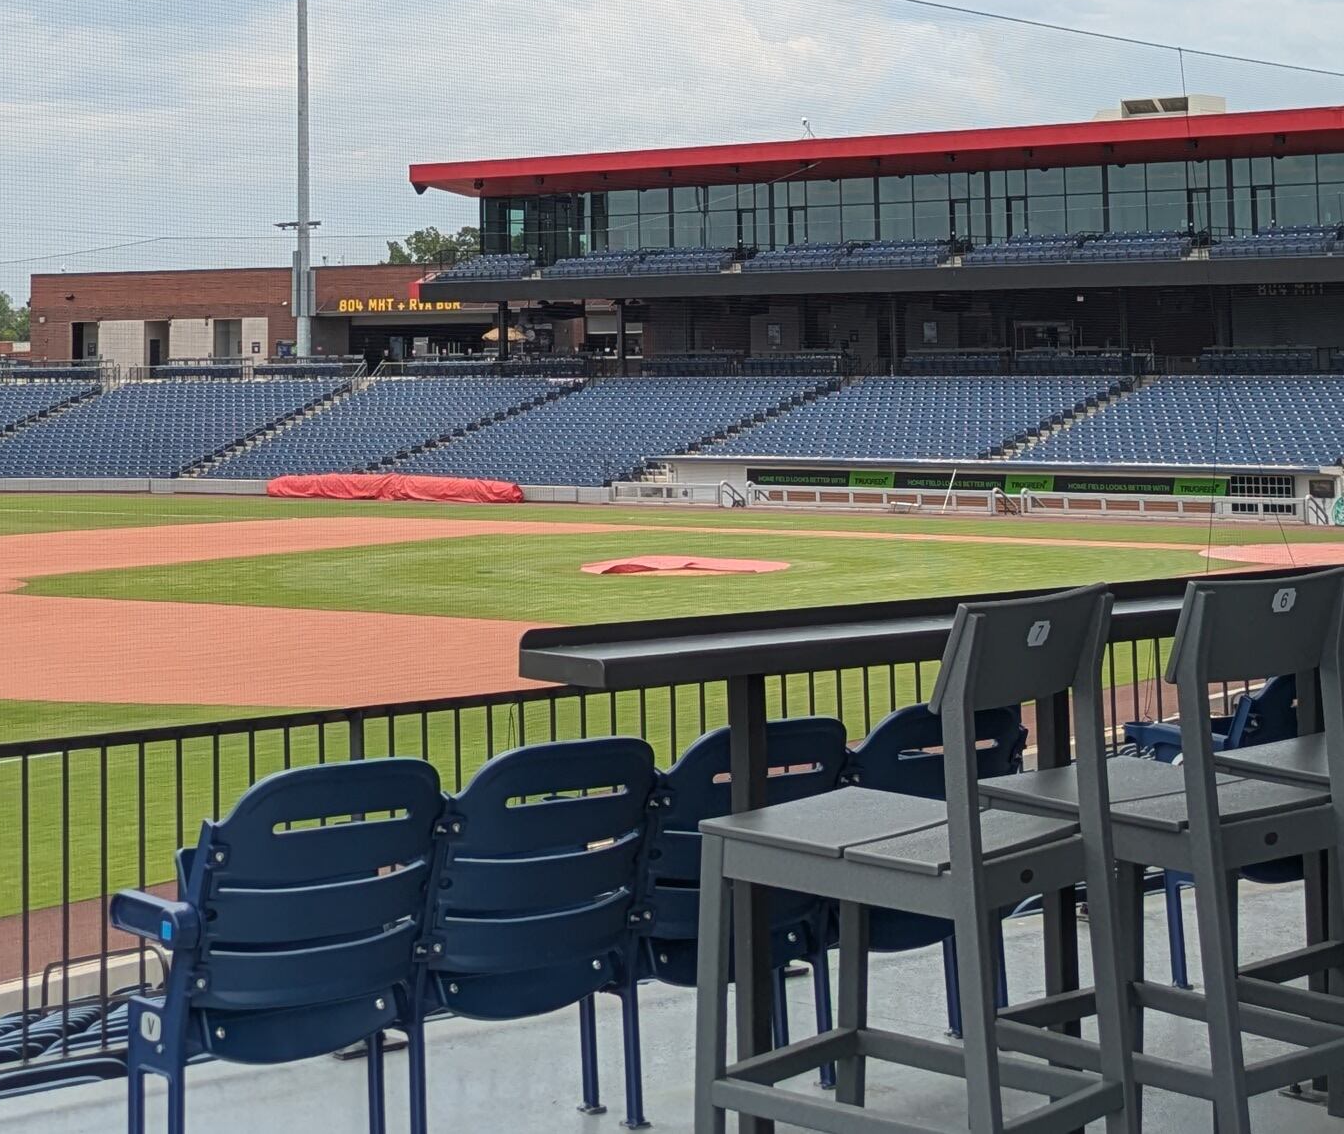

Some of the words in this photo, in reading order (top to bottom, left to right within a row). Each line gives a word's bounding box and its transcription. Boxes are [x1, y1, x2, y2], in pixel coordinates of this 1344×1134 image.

[338, 298, 364, 312] 804
[368, 297, 394, 311] MHT
[855, 477, 888, 485] TRUGREEN
[1011, 480, 1047, 488] TRUGREEN
[1181, 484, 1218, 493] TRUGREEN
[1281, 592, 1289, 608] 6
[1035, 625, 1044, 642] 7
[147, 1017, 155, 1035] V
